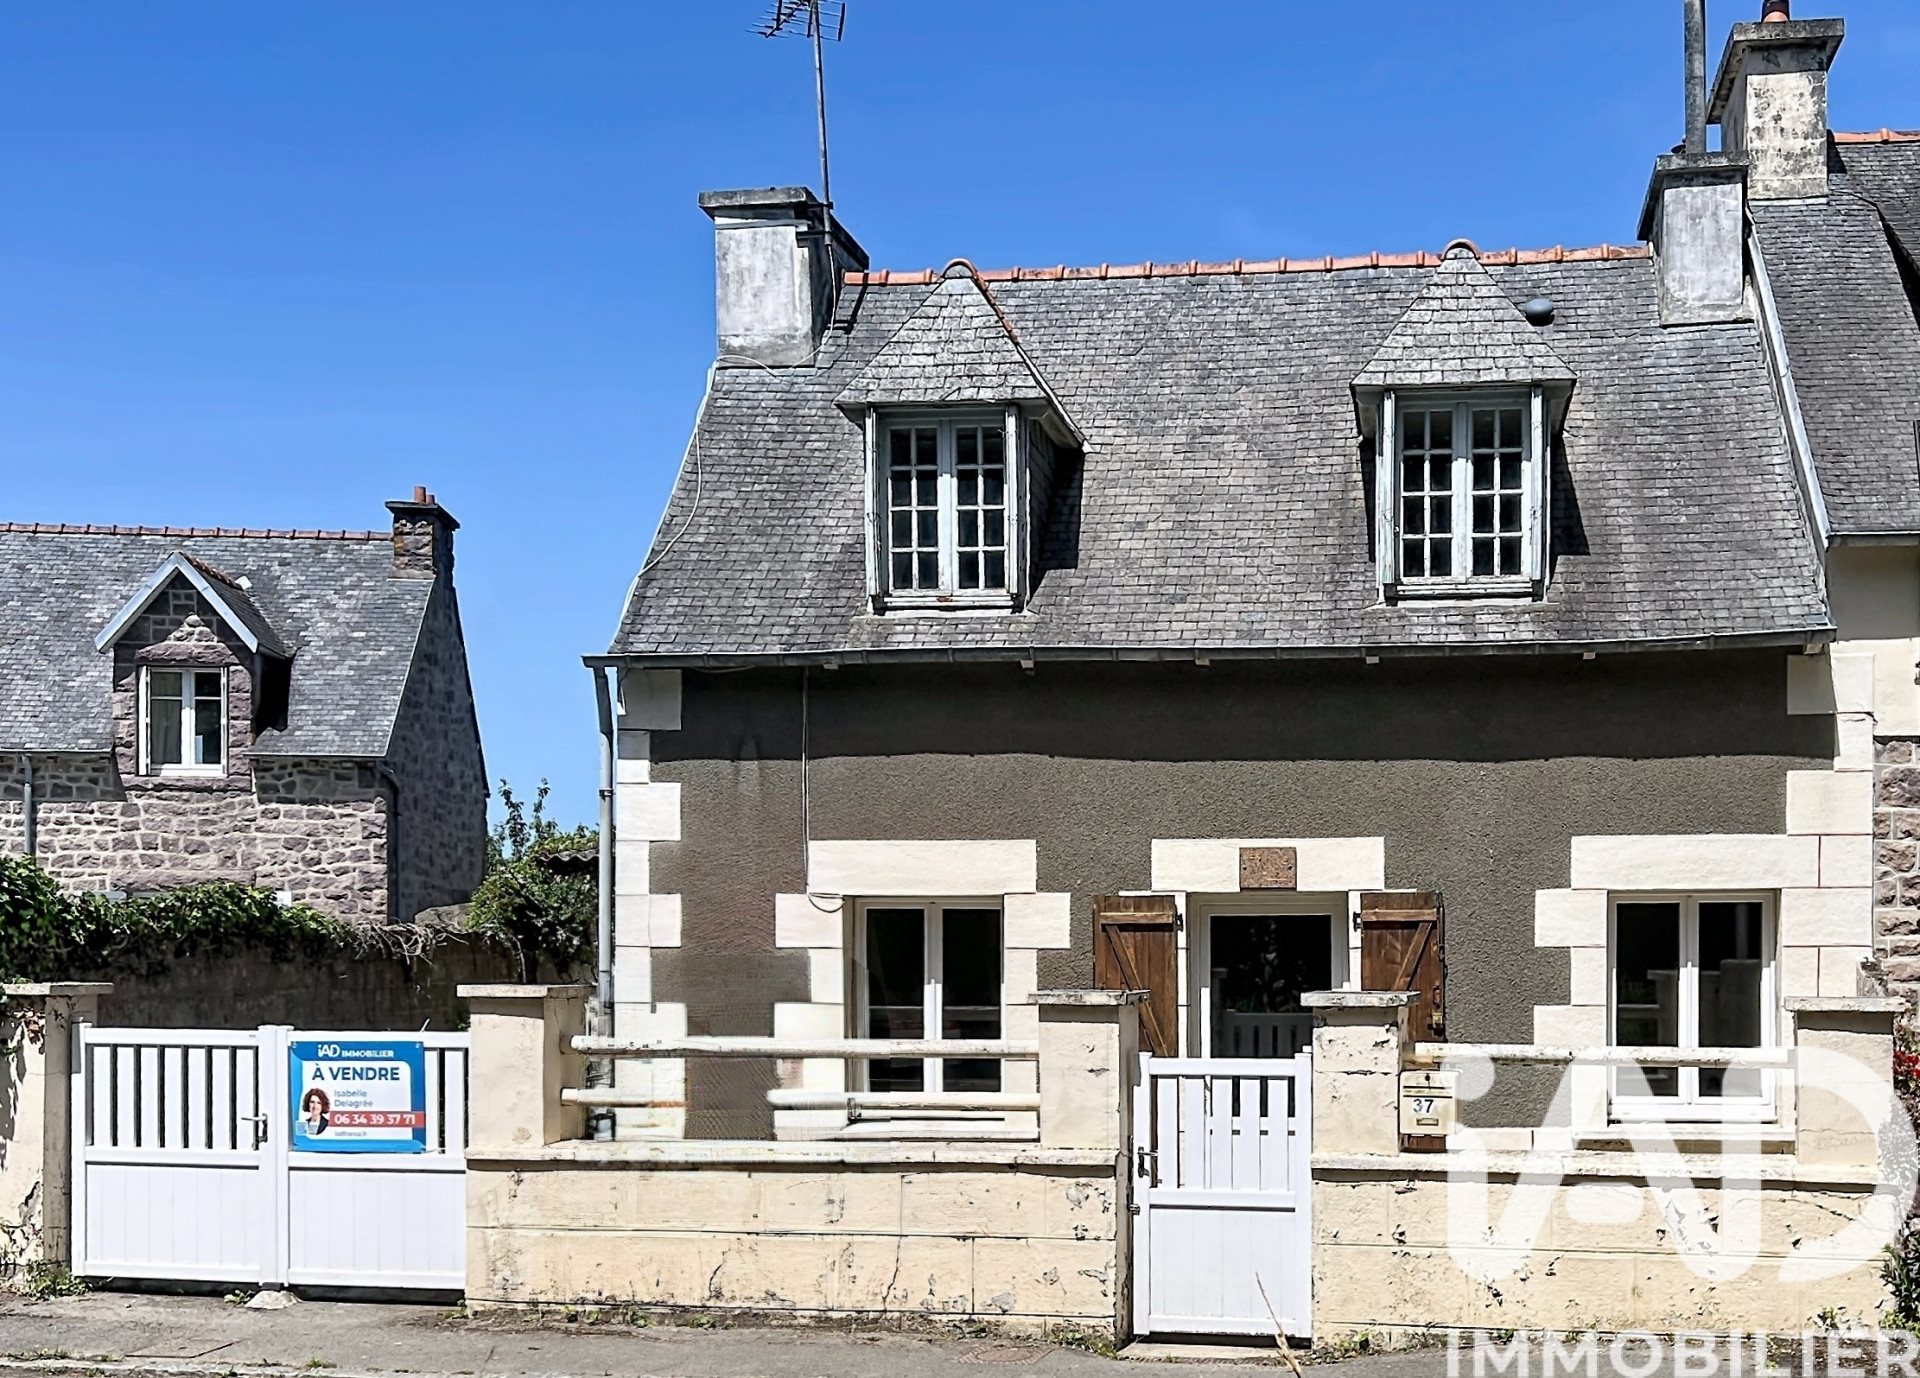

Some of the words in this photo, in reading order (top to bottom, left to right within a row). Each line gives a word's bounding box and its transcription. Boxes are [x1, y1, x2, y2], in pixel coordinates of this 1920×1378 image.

[341, 1049, 394, 1058] IMMOBILIER
[312, 1063, 325, 1081] À
[329, 1067, 400, 1081] VENDRE
[334, 1089, 367, 1098] Isabelle
[334, 1100, 373, 1109] Delagrée
[1413, 1098, 1434, 1113] 37
[334, 1114, 350, 1124] 06
[352, 1114, 367, 1124] 34
[369, 1114, 384, 1124] 39
[386, 1114, 401, 1124] 37
[402, 1114, 416, 1124] 71
